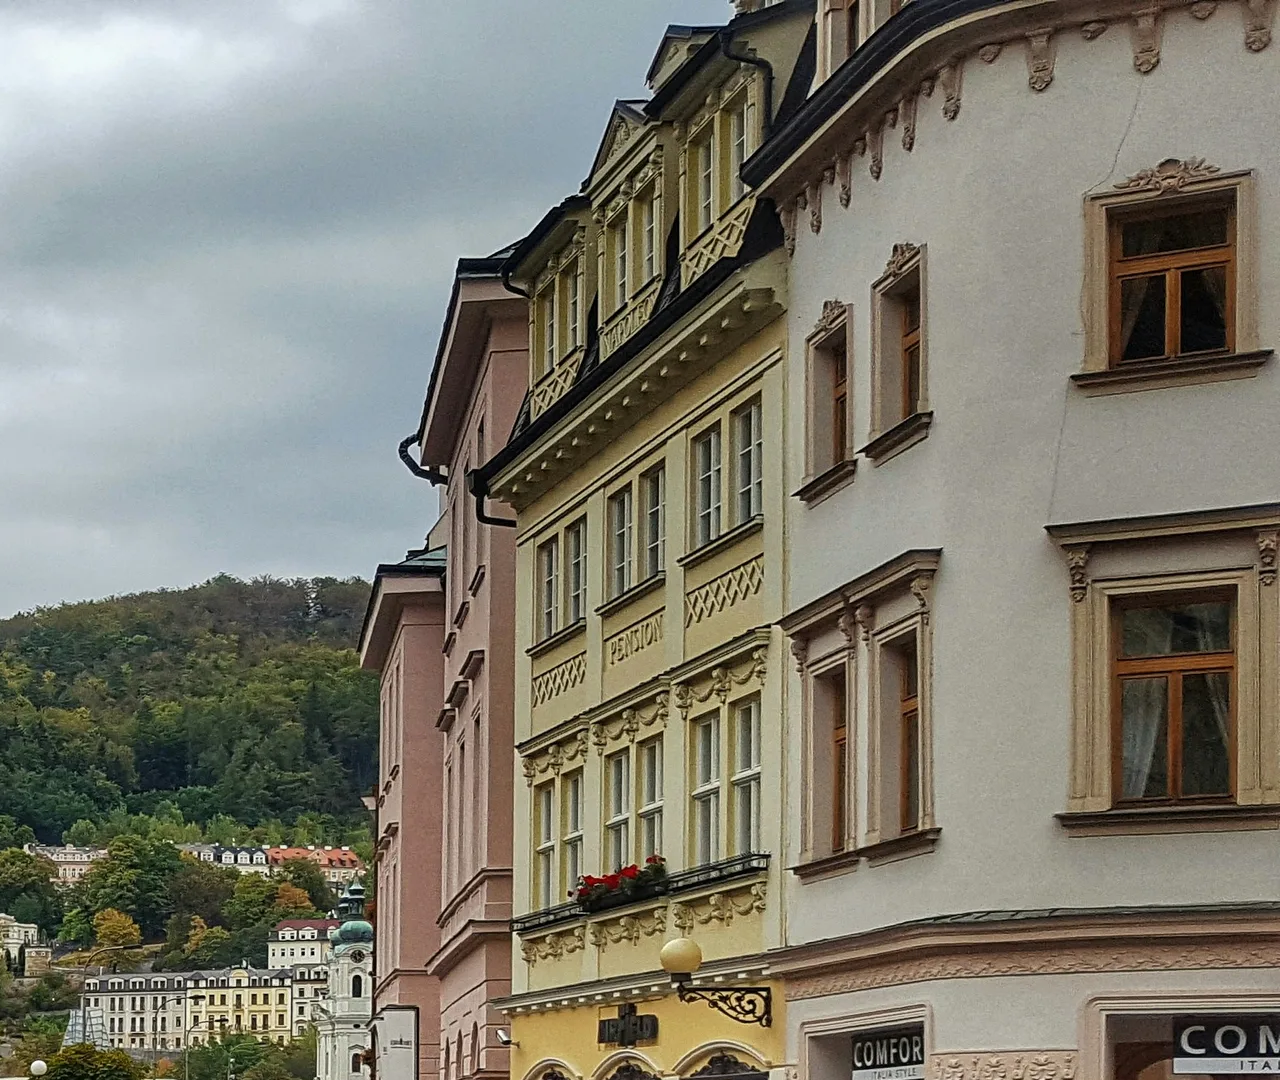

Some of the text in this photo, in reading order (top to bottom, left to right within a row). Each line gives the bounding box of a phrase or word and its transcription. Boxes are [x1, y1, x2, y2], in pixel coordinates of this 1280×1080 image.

[610, 614, 663, 665] PENSION
[854, 1036, 922, 1067] COMFOR
[895, 1067, 917, 1078] STYLE
[1240, 1061, 1280, 1070] ITA
